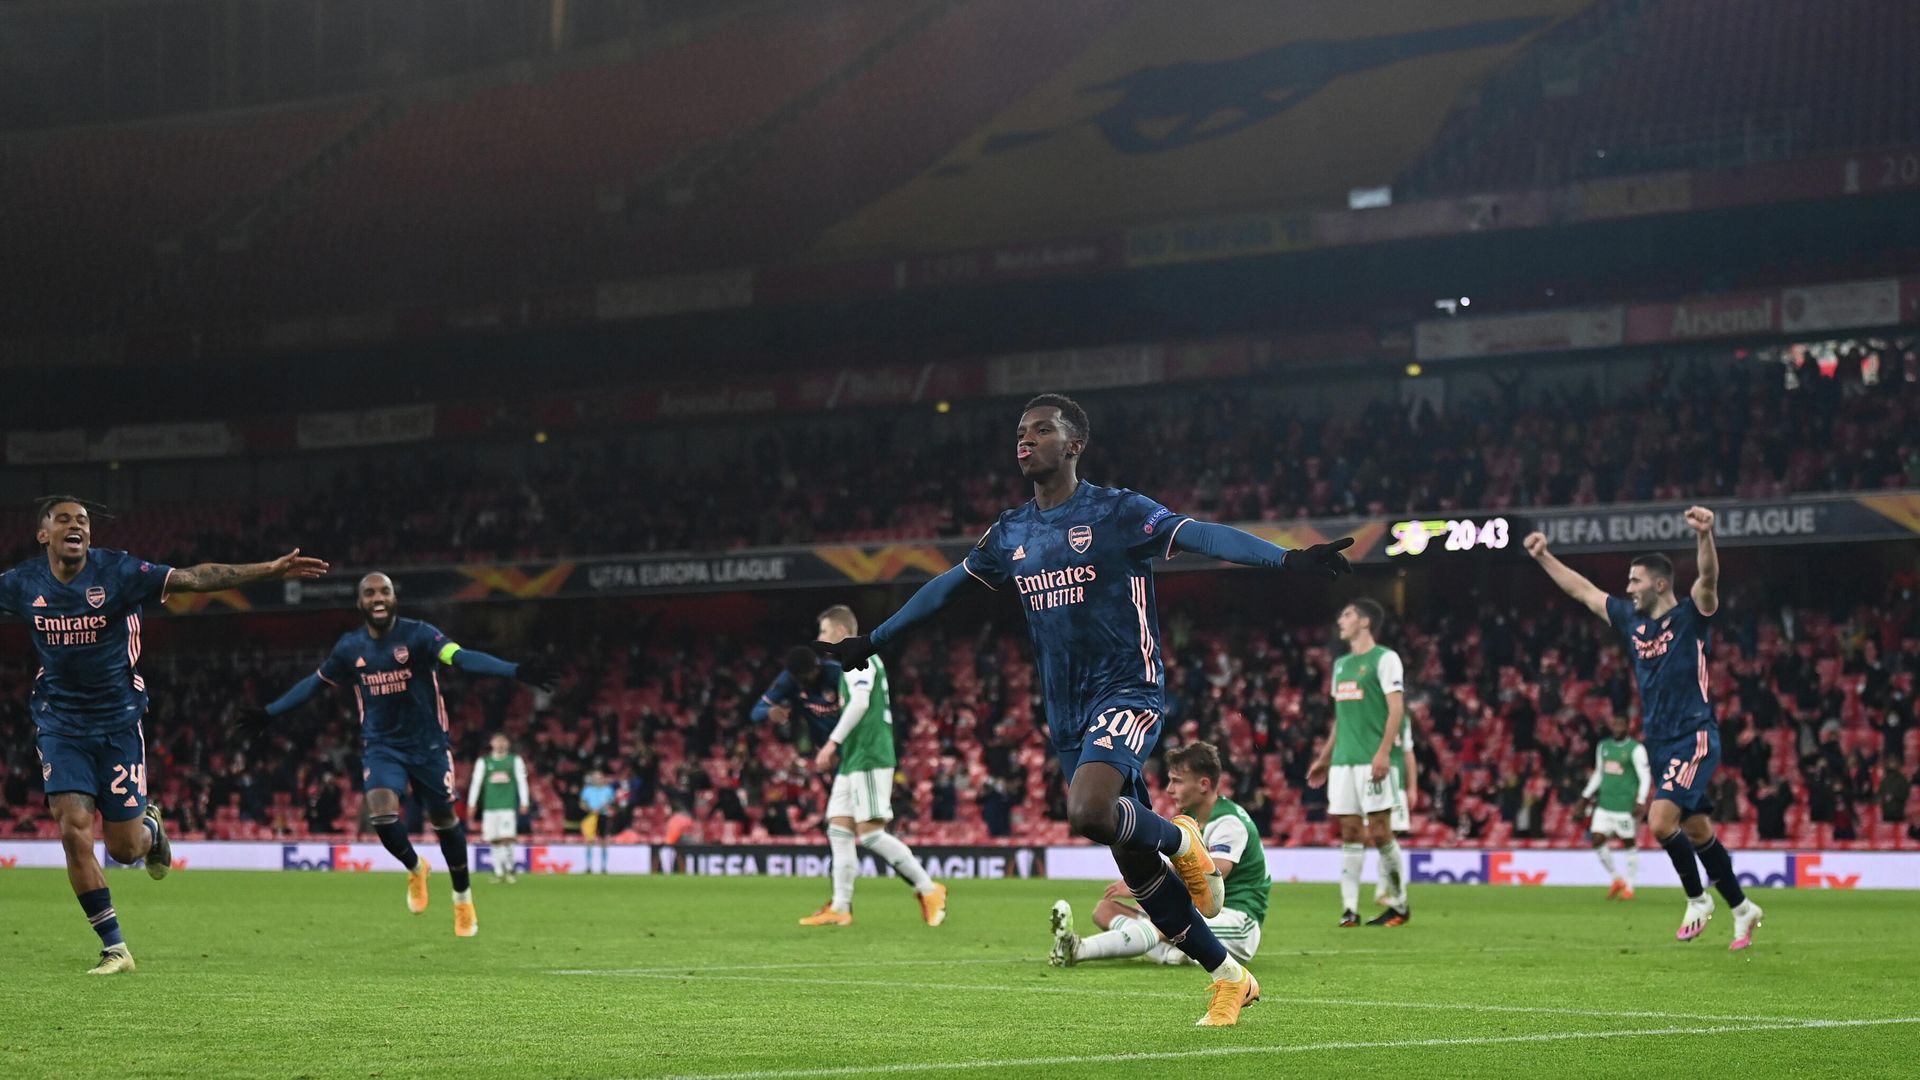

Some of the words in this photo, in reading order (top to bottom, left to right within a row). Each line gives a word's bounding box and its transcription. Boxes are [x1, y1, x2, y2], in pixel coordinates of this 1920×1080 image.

[1671, 298, 1771, 337] Arsenal
[1445, 517, 1509, 551] 20:43
[1538, 516, 1603, 544] UEFA
[1608, 511, 1699, 541] EUROP
[1714, 507, 1816, 537] LEAGUE
[588, 564, 637, 589] UEFA
[639, 560, 709, 586] EUROPA
[711, 556, 787, 583] LEAGUE
[1015, 564, 1097, 594] Emirates
[1030, 593, 1044, 612] FLY
[1047, 586, 1085, 609] BETTER
[34, 614, 107, 631] Emirates
[47, 632, 60, 645] FLY
[63, 630, 97, 645] BETTER
[361, 668, 413, 686] Emirates
[111, 763, 144, 796] 24
